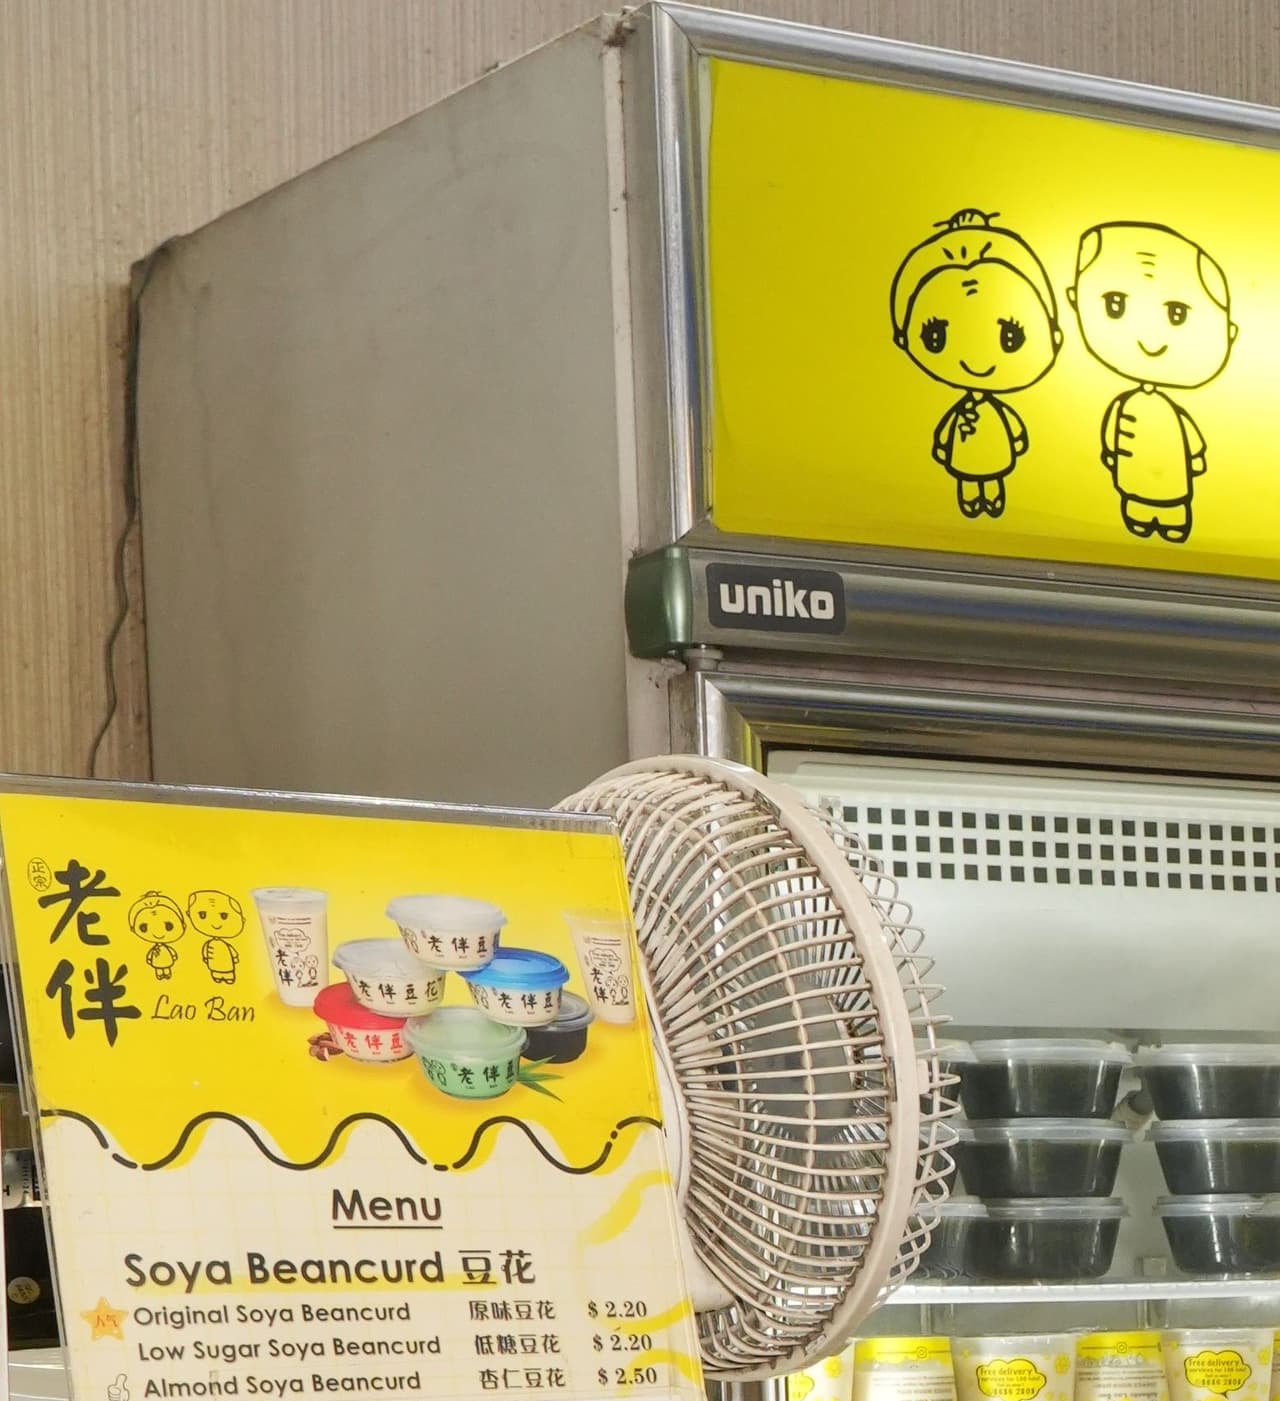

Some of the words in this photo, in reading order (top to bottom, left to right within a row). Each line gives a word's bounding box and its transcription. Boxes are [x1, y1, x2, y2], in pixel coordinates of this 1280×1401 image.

[719, 579, 835, 622] uniko
[38, 859, 142, 1047] 老伴
[151, 994, 197, 1021] Lao
[207, 996, 255, 1022] Ban
[331, 1190, 443, 1221] Menu
[124, 1253, 232, 1293] Soya
[247, 1251, 445, 1285] Beancurd
[458, 1250, 536, 1286] 豆花
[133, 1302, 229, 1328] Original
[236, 1303, 294, 1326] Soya
[301, 1301, 411, 1322] Beancurd
[468, 1300, 556, 1321] 原味豆花
[605, 1300, 647, 1319] 2.20
[138, 1341, 184, 1362] Low
[191, 1339, 261, 1364] Sugar
[268, 1337, 325, 1361] Soya
[332, 1335, 442, 1356] Beancurd
[474, 1333, 561, 1356] 低糖豆花
[609, 1333, 653, 1351] 2.20
[144, 1376, 240, 1398] Almond
[246, 1374, 305, 1397] Soya
[314, 1371, 421, 1392] Beancurd
[479, 1368, 567, 1389] 杏仁豆花
[613, 1366, 657, 1385] 2.50
